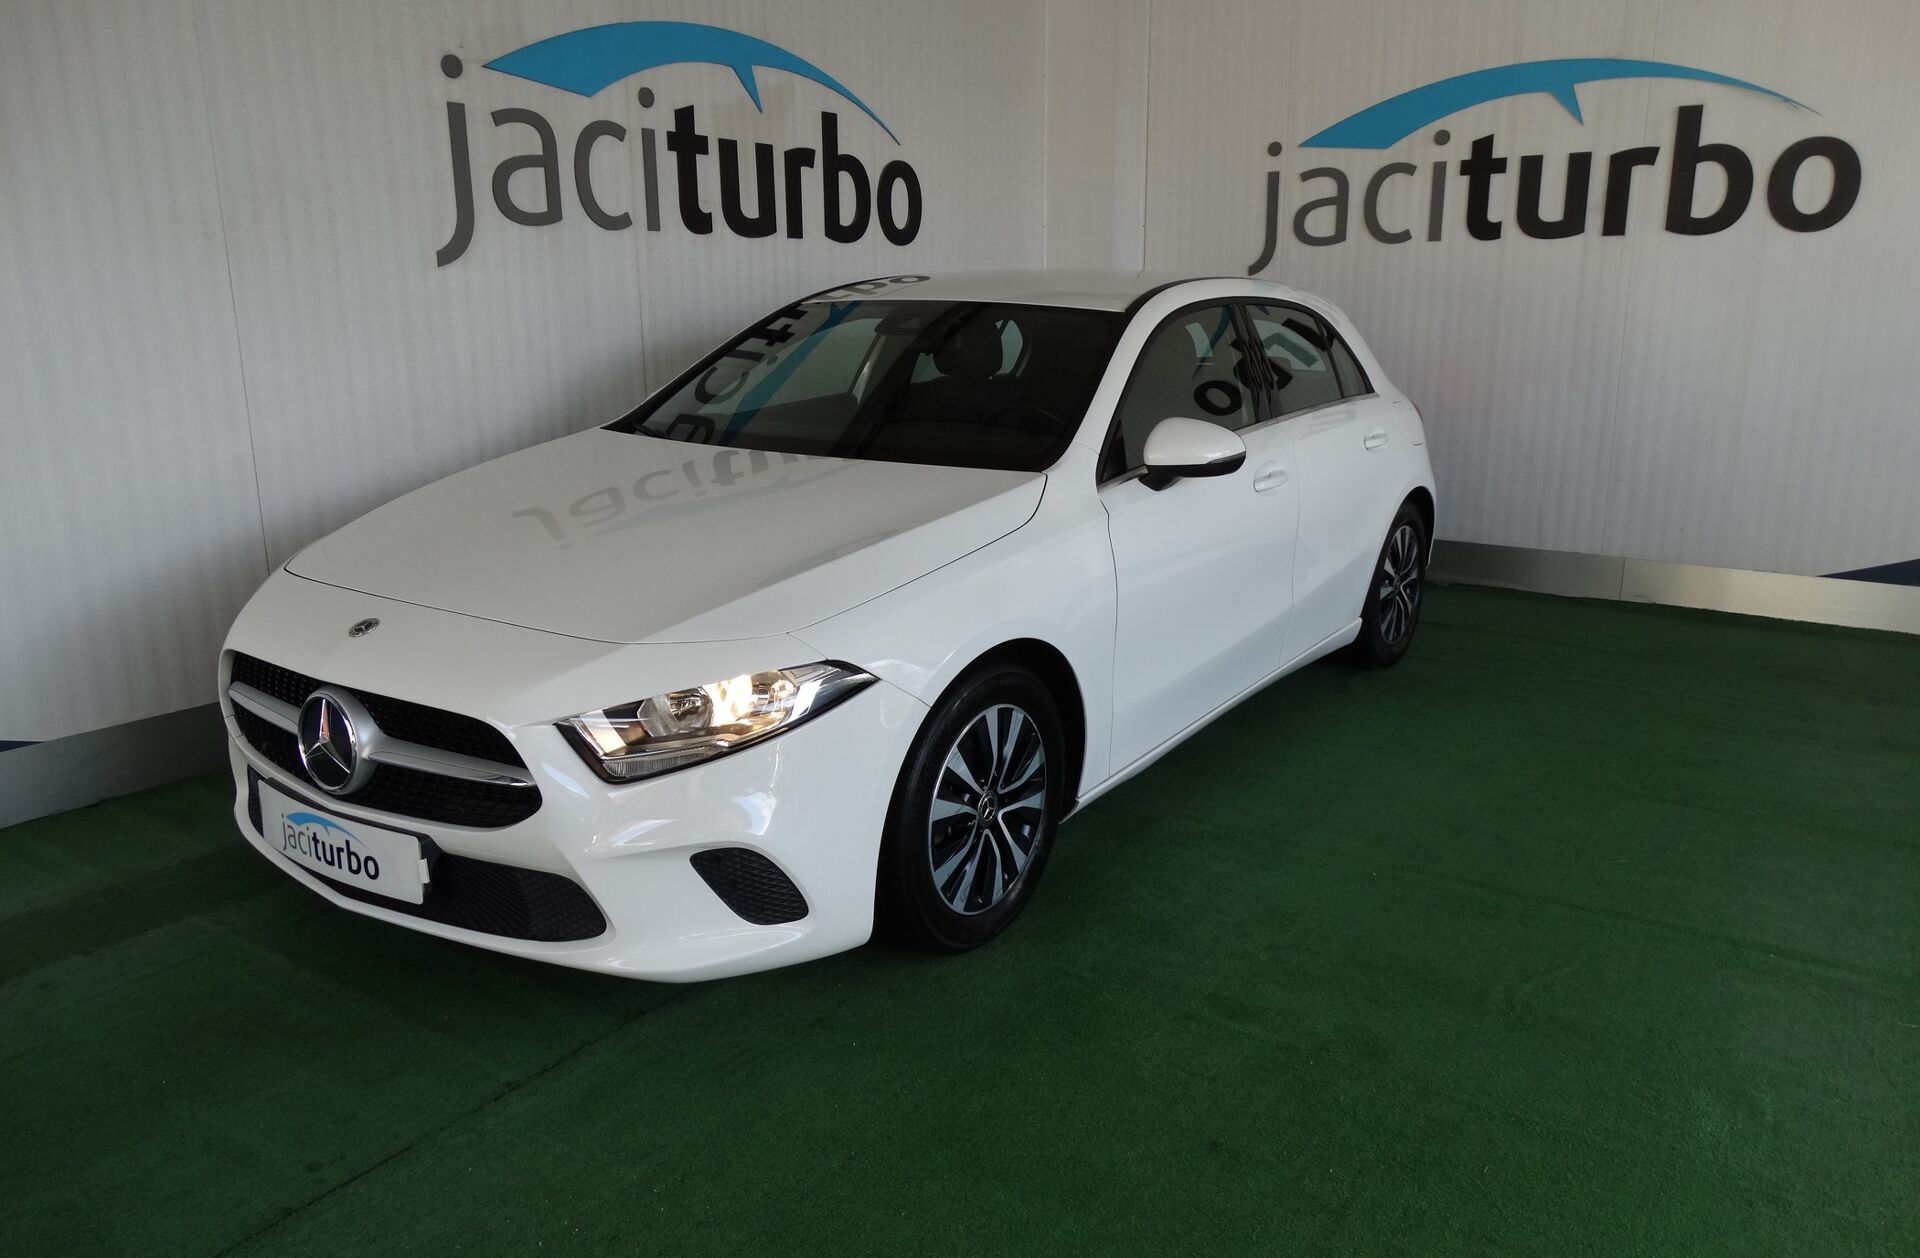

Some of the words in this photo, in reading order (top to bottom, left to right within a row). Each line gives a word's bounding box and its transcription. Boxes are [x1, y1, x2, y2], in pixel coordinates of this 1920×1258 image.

[436, 53, 923, 268] jaciturbo
[1247, 104, 1862, 276] jaciturbo
[281, 813, 380, 881] jaciturbo
